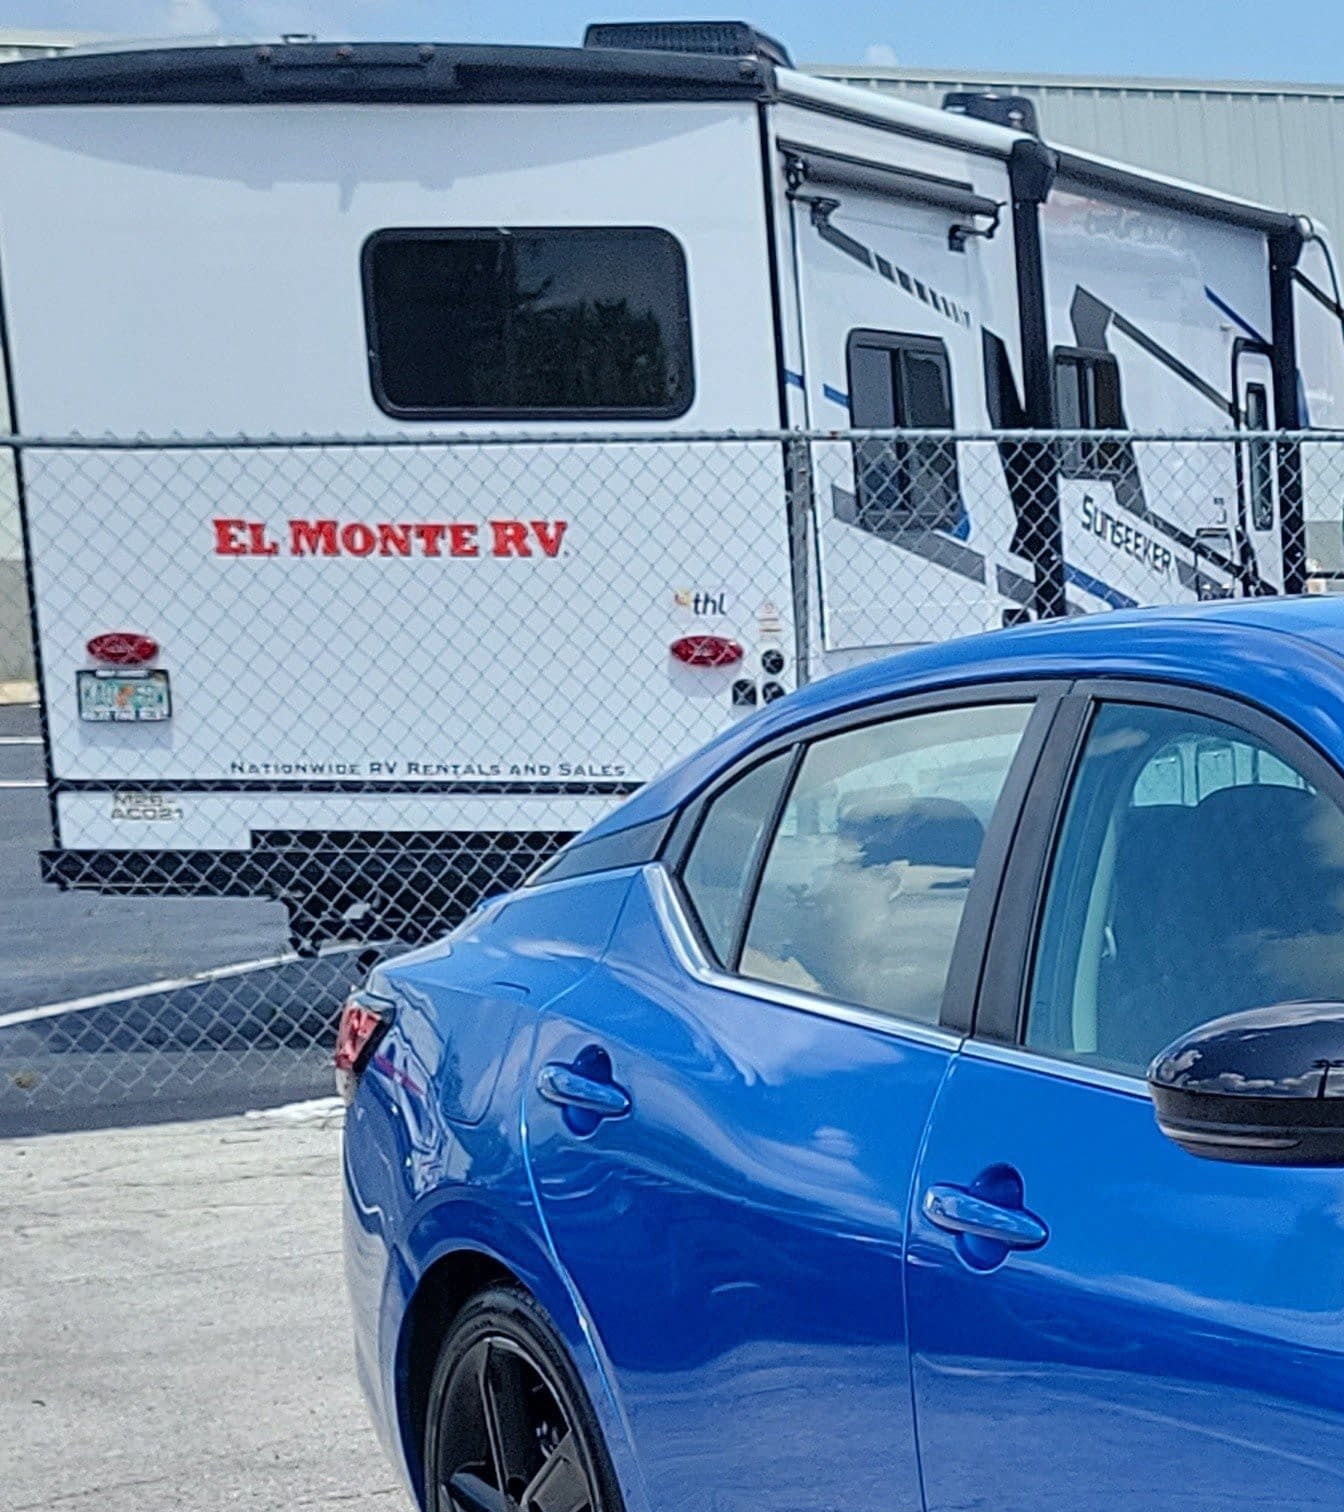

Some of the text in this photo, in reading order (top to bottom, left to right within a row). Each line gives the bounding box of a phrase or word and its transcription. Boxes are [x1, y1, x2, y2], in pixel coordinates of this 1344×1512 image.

[212, 519, 568, 558] EL MONTE RV
[693, 591, 727, 616] thl
[230, 761, 626, 777] NATIONWIDE RV RENTALS AND SALES
